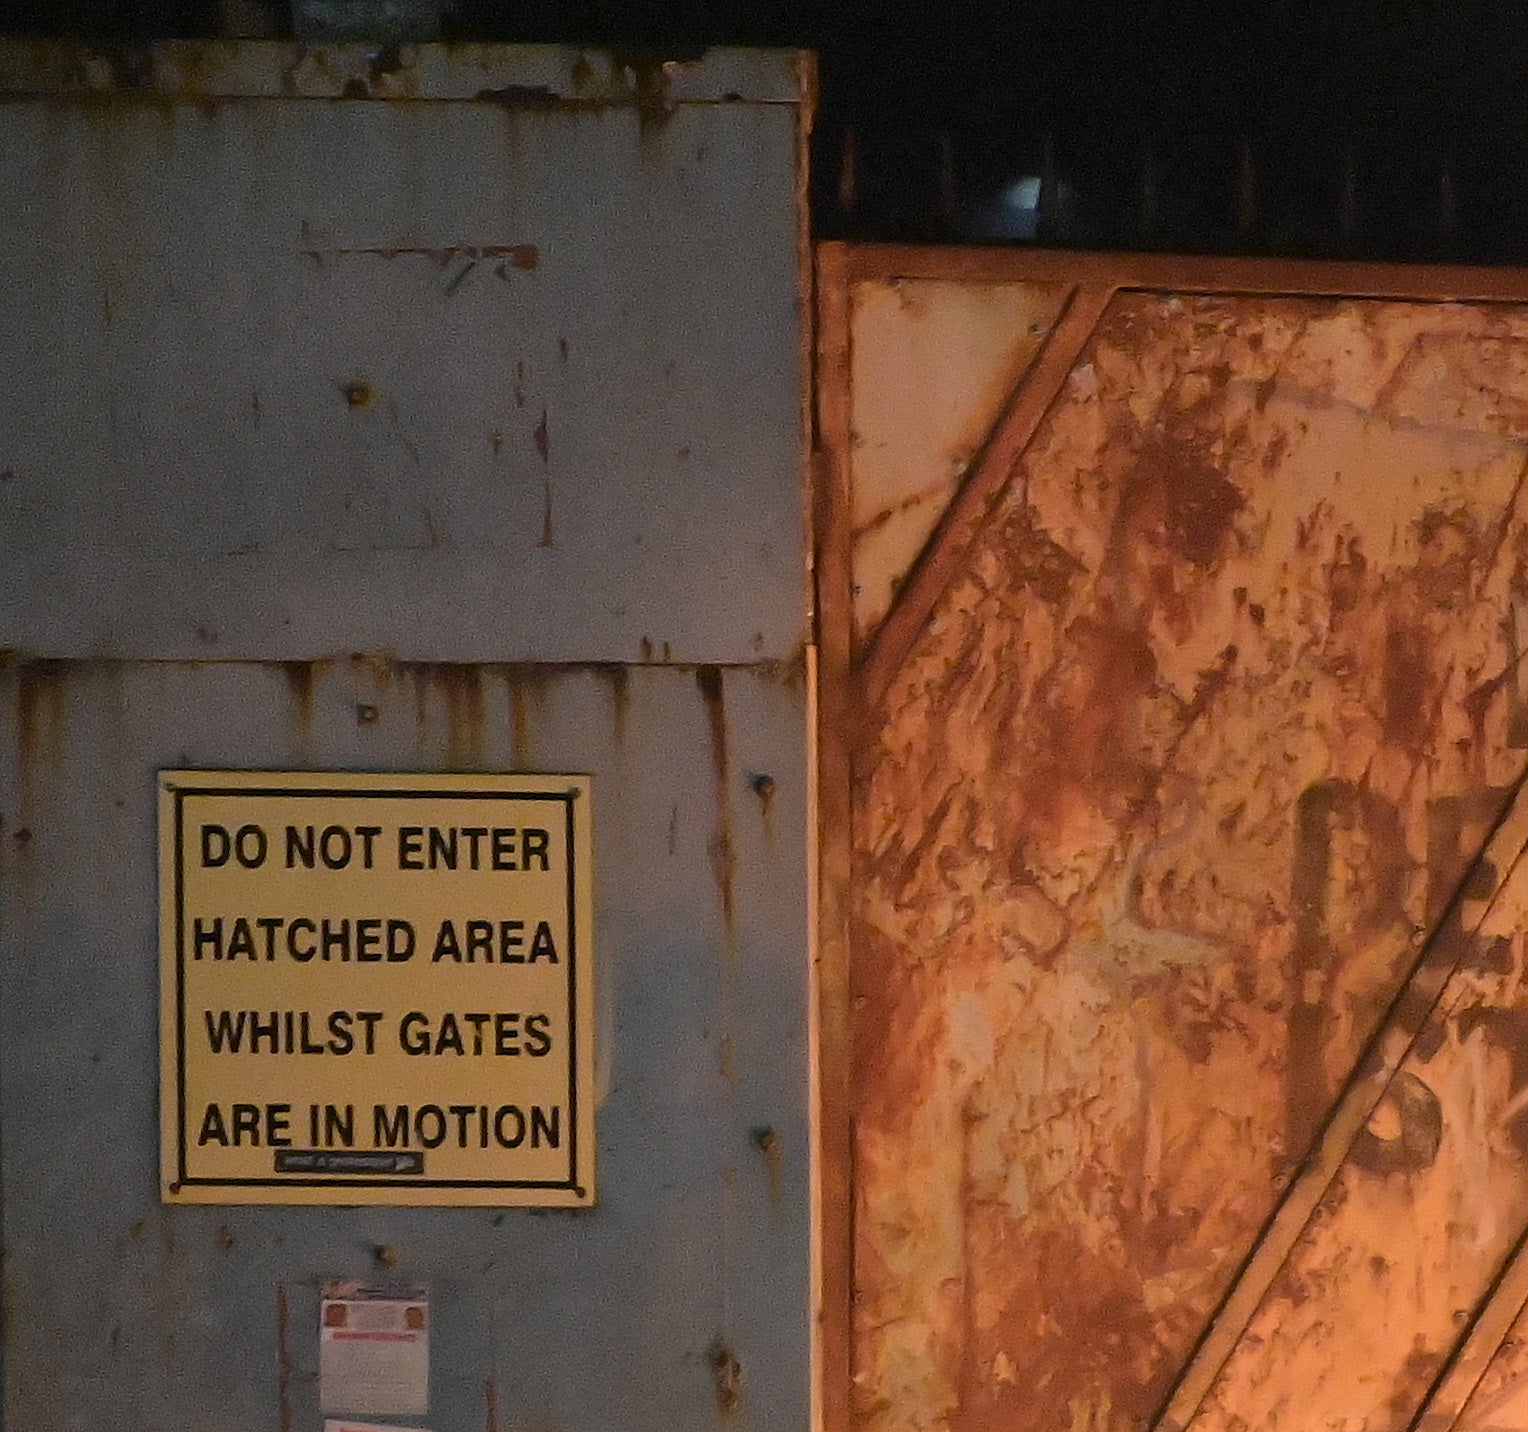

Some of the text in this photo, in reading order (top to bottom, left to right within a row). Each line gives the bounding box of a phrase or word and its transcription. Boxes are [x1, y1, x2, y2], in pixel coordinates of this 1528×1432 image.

[202, 825, 550, 871] DO NOT ENTER
[194, 918, 559, 963] HATCHED AREA
[205, 1010, 552, 1057] WHILST GATES
[198, 1103, 560, 1149] ARE IN MOTION
